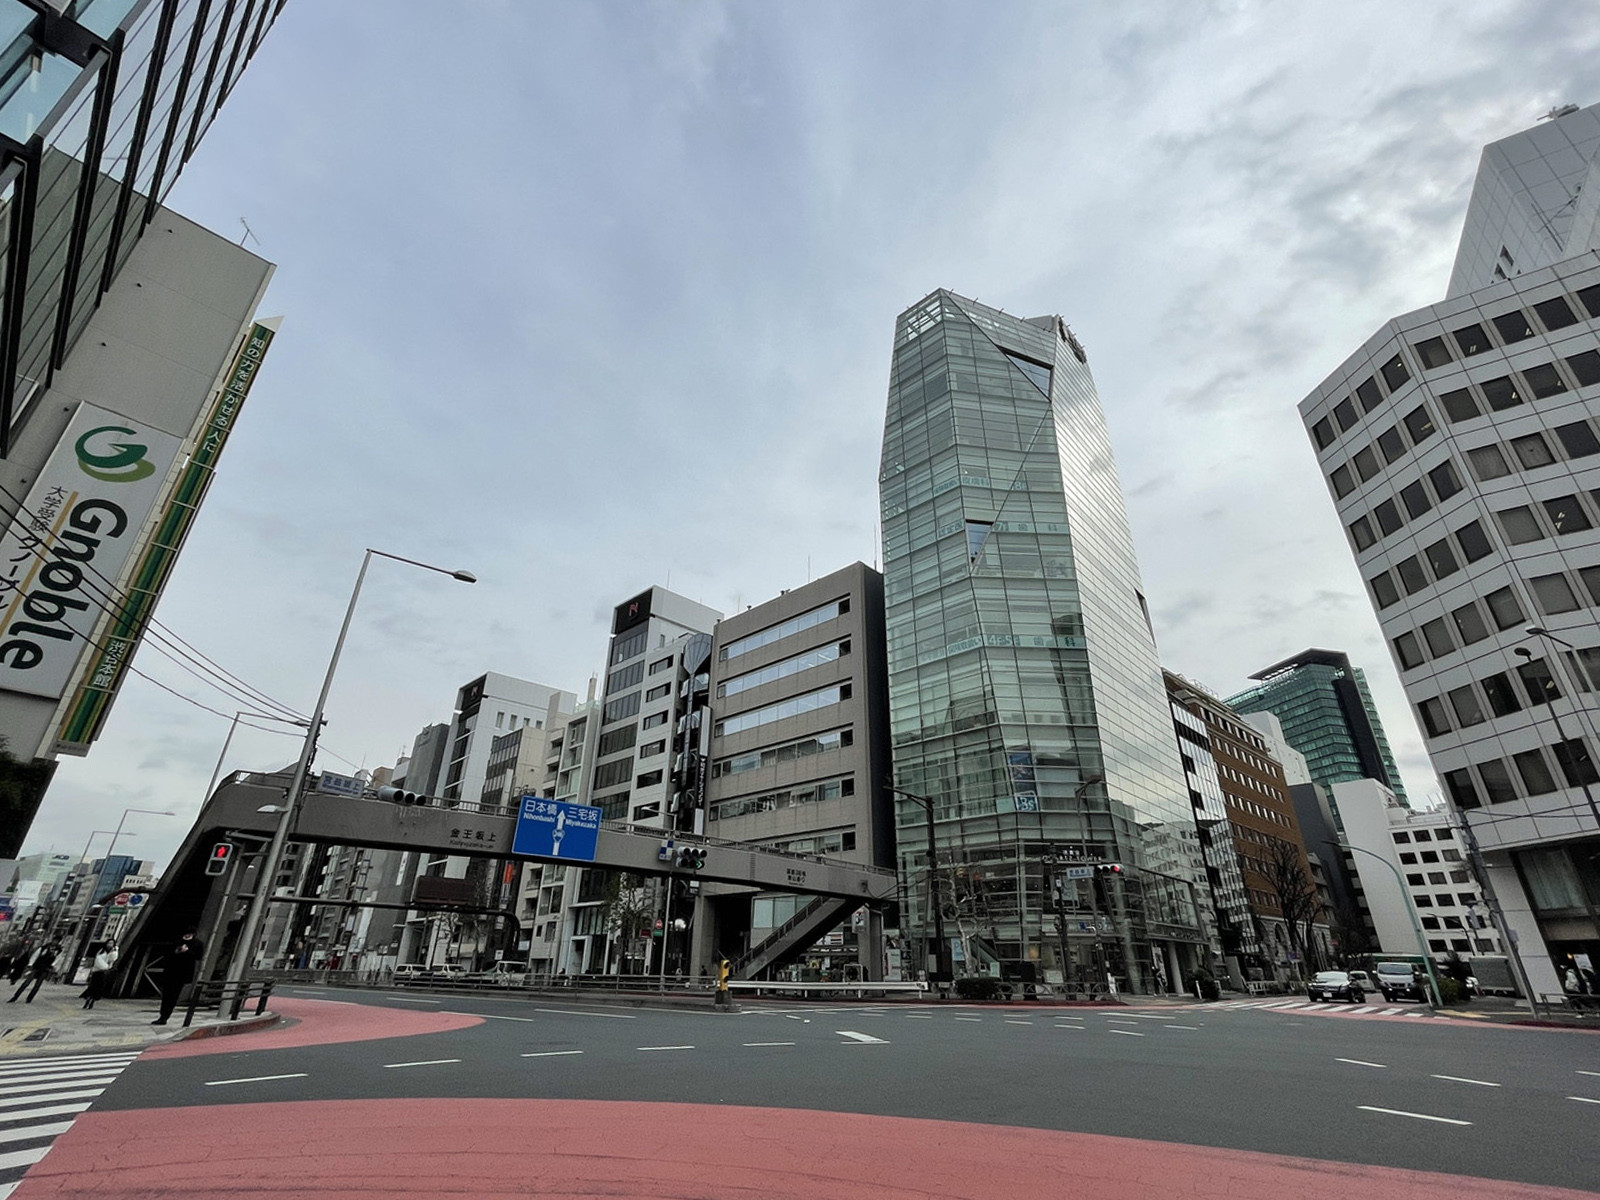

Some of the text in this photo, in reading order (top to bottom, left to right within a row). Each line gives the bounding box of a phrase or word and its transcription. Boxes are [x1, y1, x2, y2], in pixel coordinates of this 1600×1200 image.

[202, 337, 266, 453] 知の力を活かせる人に
[28, 486, 69, 534] 大学受験
[0, 498, 128, 670] Gnoble
[93, 640, 126, 688] 渋谷本館
[450, 828, 497, 842] 金王坂上
[523, 812, 556, 823] Nihonbashi
[525, 800, 599, 822] 日本橋 三宅坂
